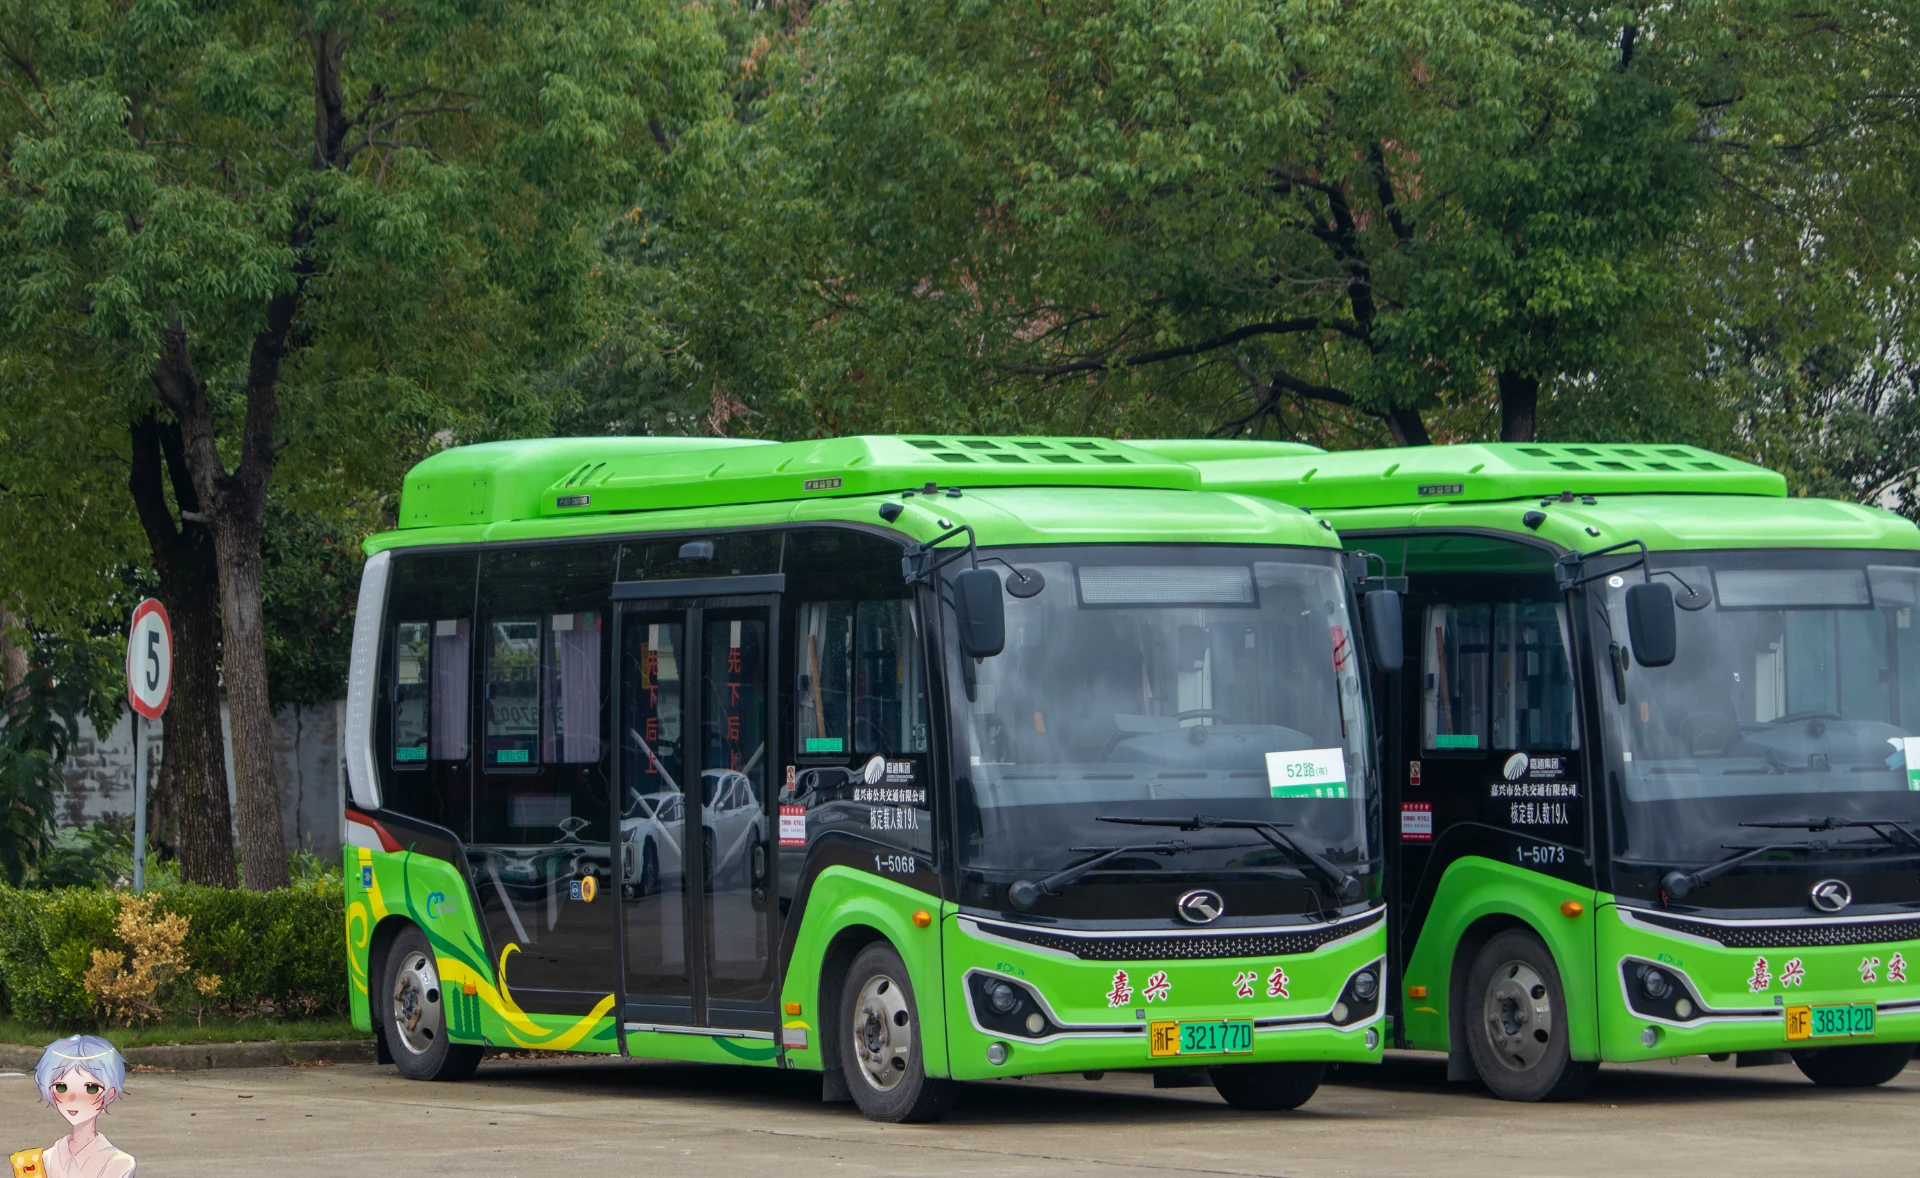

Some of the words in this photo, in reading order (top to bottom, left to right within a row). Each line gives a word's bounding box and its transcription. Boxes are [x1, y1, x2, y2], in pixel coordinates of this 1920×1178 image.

[146, 630, 160, 691] 5
[1530, 758, 1559, 770] 嘉通集团
[853, 788, 926, 803] 嘉兴市公共交通有限公司
[1490, 783, 1577, 797] 嘉兴市公共交通有限公司
[870, 807, 919, 830] 核定载人数19人
[1510, 802, 1569, 825] 核定载人数19人
[1516, 846, 1565, 863] 1-5073
[875, 855, 915, 873] 1-5068
[1185, 1025, 1251, 1050] 32177D
